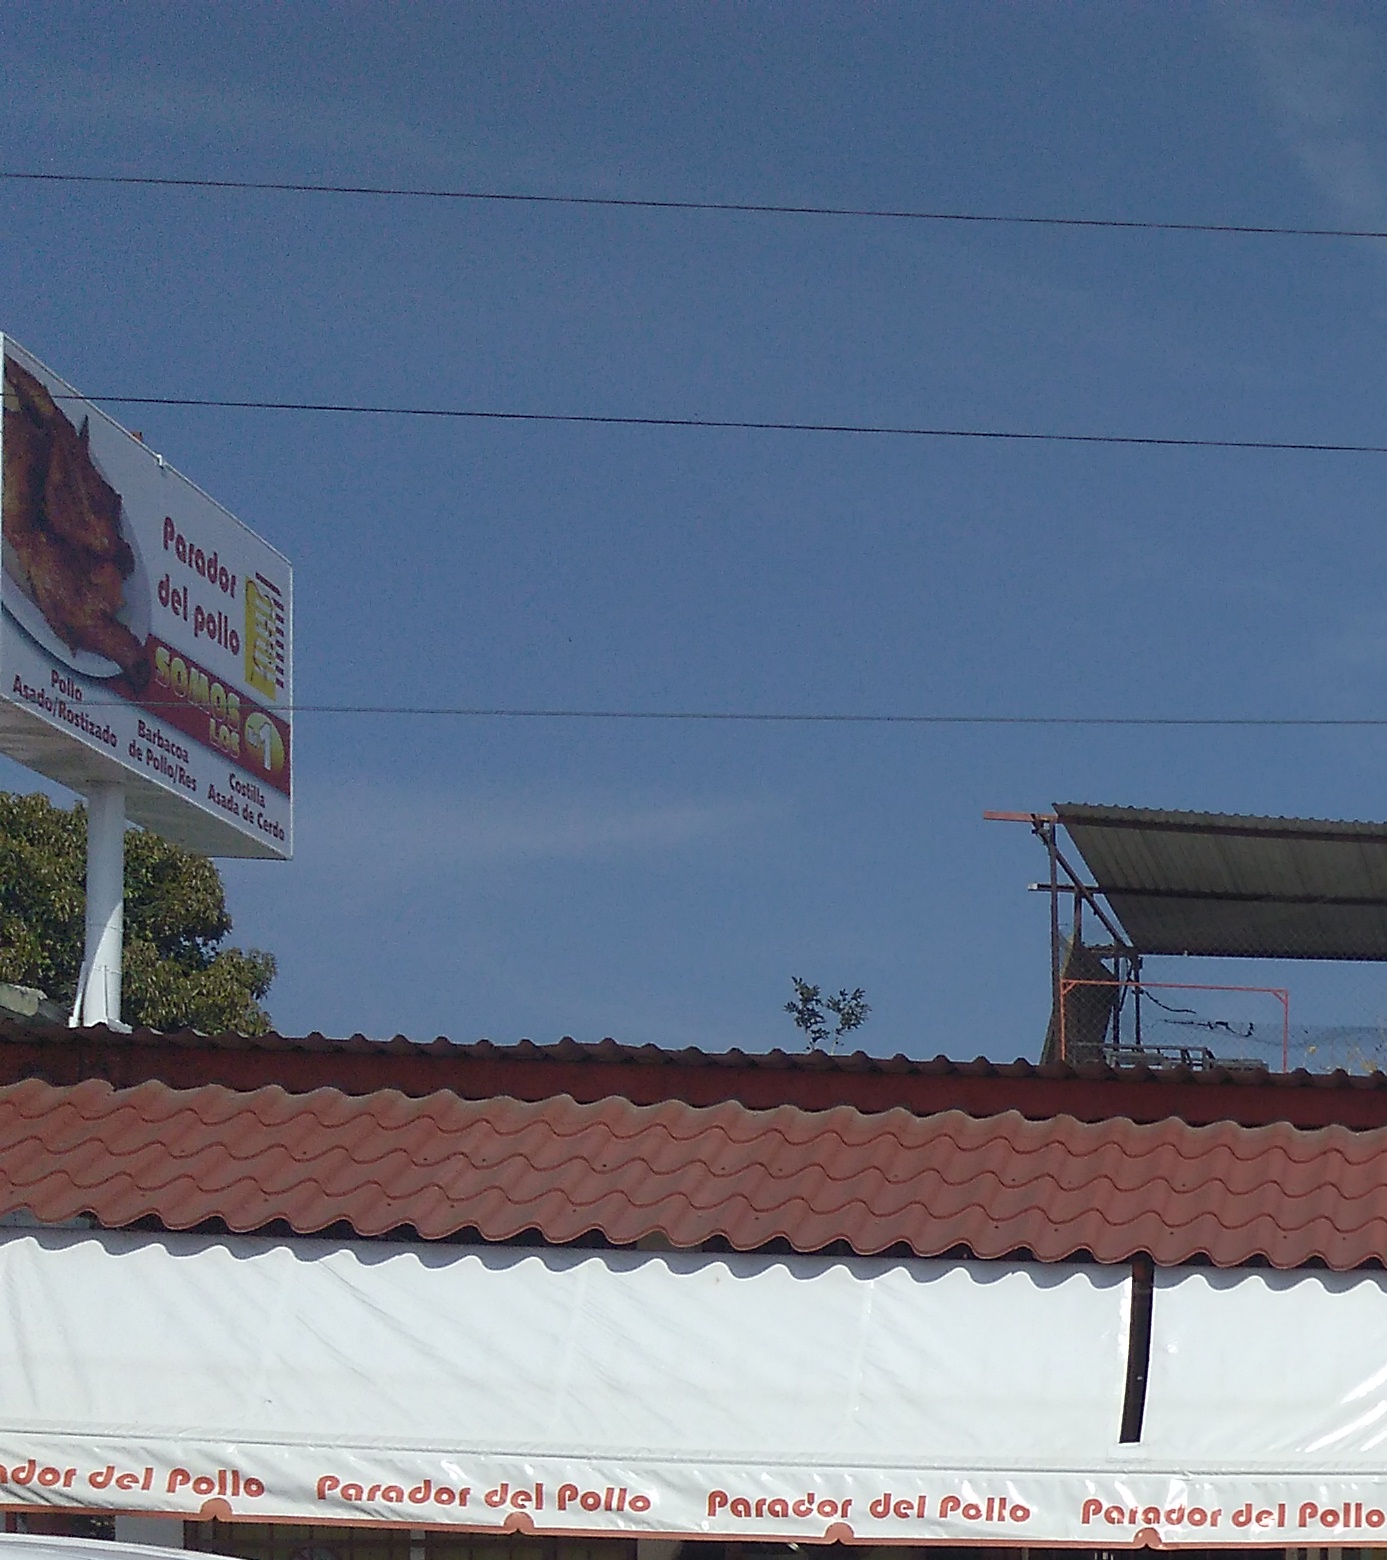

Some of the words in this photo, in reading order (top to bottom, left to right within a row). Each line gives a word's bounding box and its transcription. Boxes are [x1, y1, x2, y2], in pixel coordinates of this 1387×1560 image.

[163, 517, 236, 599] Parador
[158, 574, 188, 621] del
[194, 604, 240, 656] pollo
[51, 669, 83, 701] Pollo
[155, 647, 241, 732] SOMOS
[137, 719, 189, 764] Barbacoa
[128, 740, 143, 762] de
[145, 749, 197, 793] Pollo/Res
[228, 772, 266, 808] Costilla
[207, 784, 239, 816] Asada
[242, 803, 254, 825] de
[257, 812, 285, 841] Cerdo
[88, 1464, 154, 1491] del
[166, 1467, 266, 1498] Pollo
[316, 1475, 471, 1507] Parador
[484, 1482, 544, 1510] del
[557, 1483, 652, 1512] Pollo
[707, 1489, 853, 1518] Parador
[869, 1492, 927, 1520] del
[939, 1495, 1032, 1523] Pollo
[1081, 1498, 1223, 1528] Parador
[1231, 1502, 1287, 1529] del
[1298, 1501, 1386, 1528] Pollo
